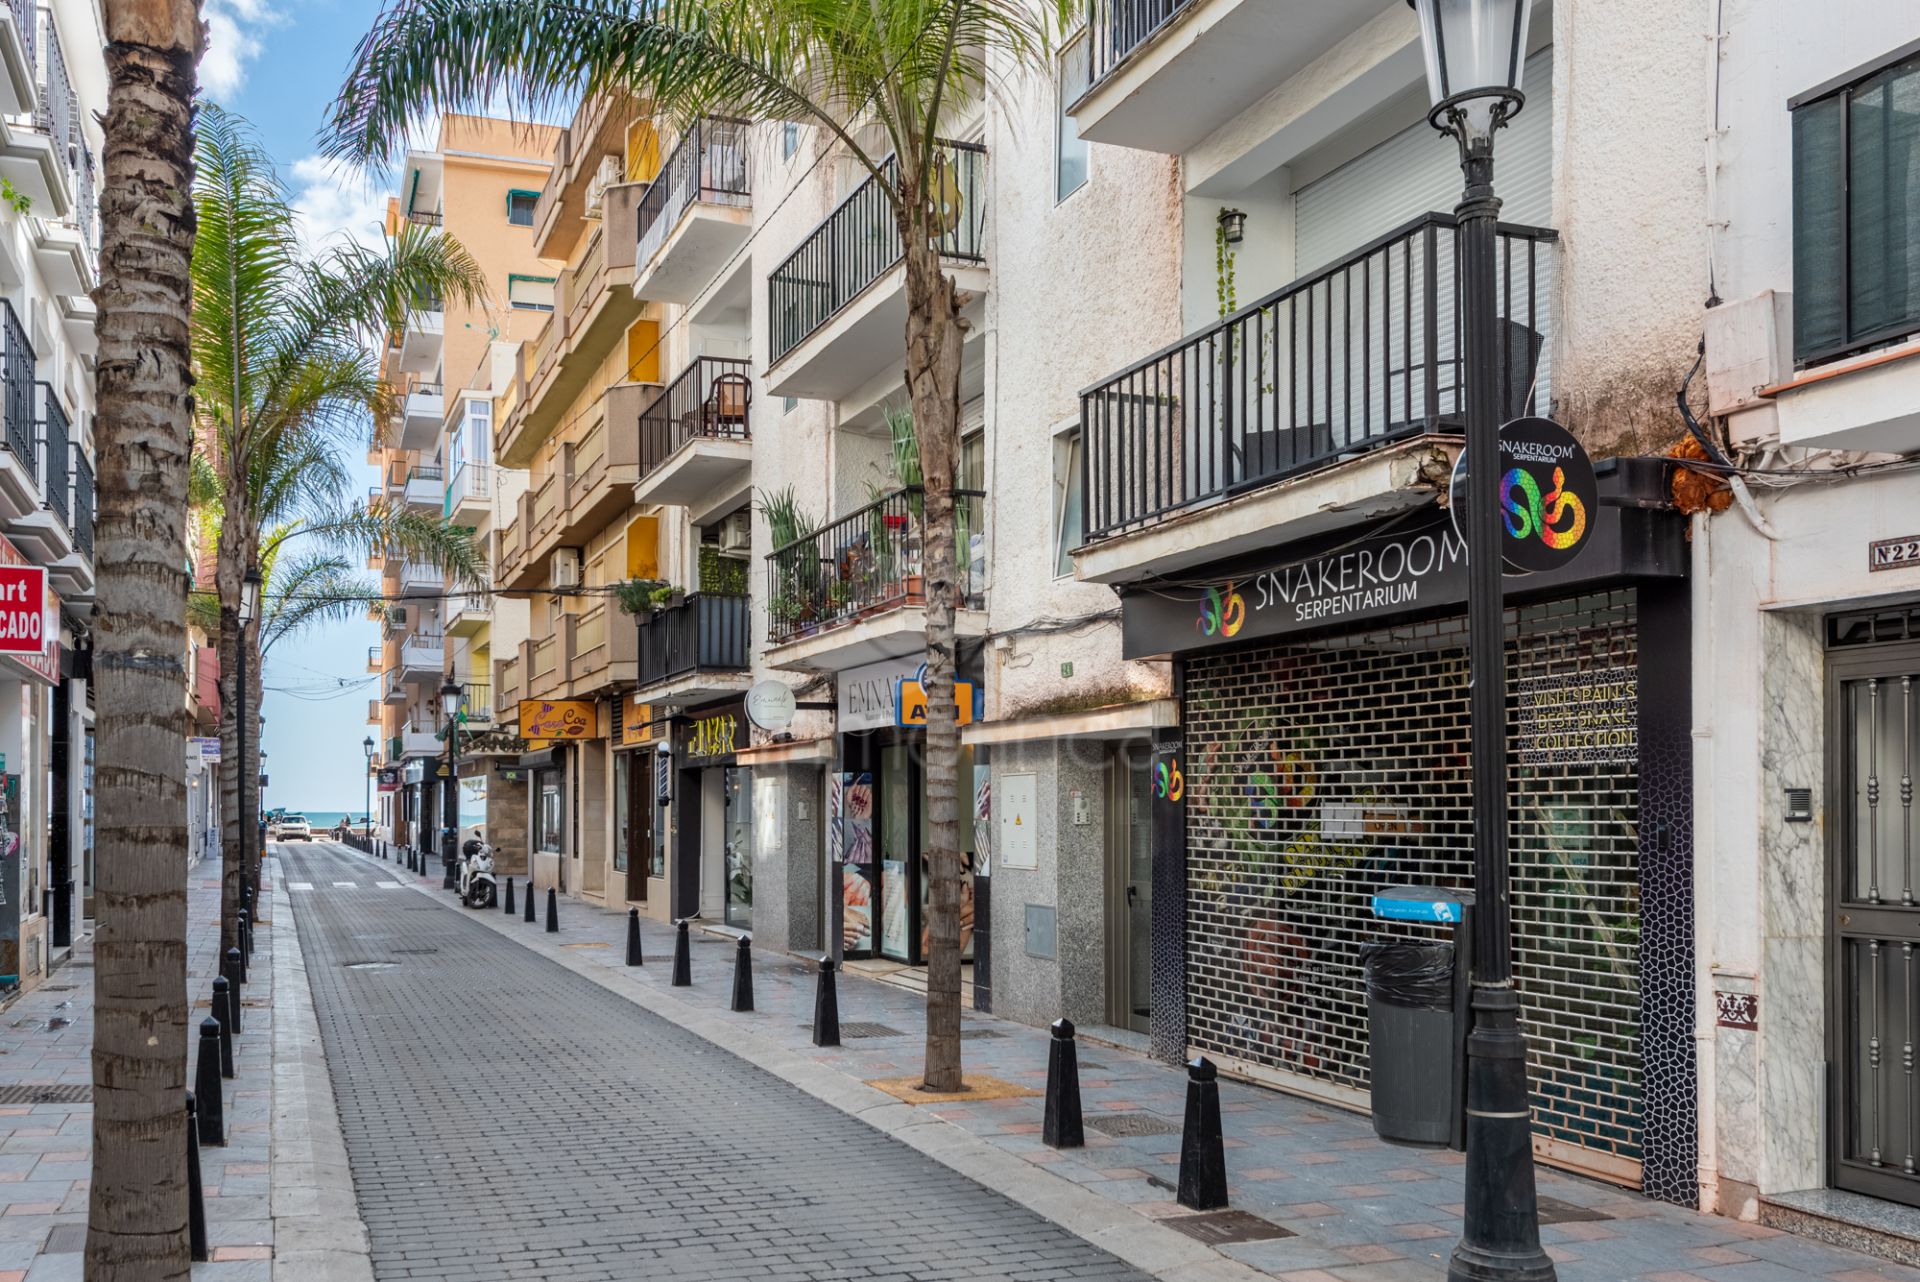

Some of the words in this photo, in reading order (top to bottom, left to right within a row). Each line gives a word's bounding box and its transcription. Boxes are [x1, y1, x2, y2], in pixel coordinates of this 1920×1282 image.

[1513, 453, 1557, 464] SERPENTARIUM
[1893, 543, 1919, 560] 22
[1255, 530, 1469, 610] SNAKEROOM
[1295, 580, 1418, 622] SERPENTARIUM
[1534, 690, 1567, 706] VISIT
[1573, 684, 1635, 703] SPAIN'S
[1538, 711, 1574, 729] BEST
[1578, 707, 1631, 726] SNAKE
[1537, 729, 1633, 749] COLLECTION
